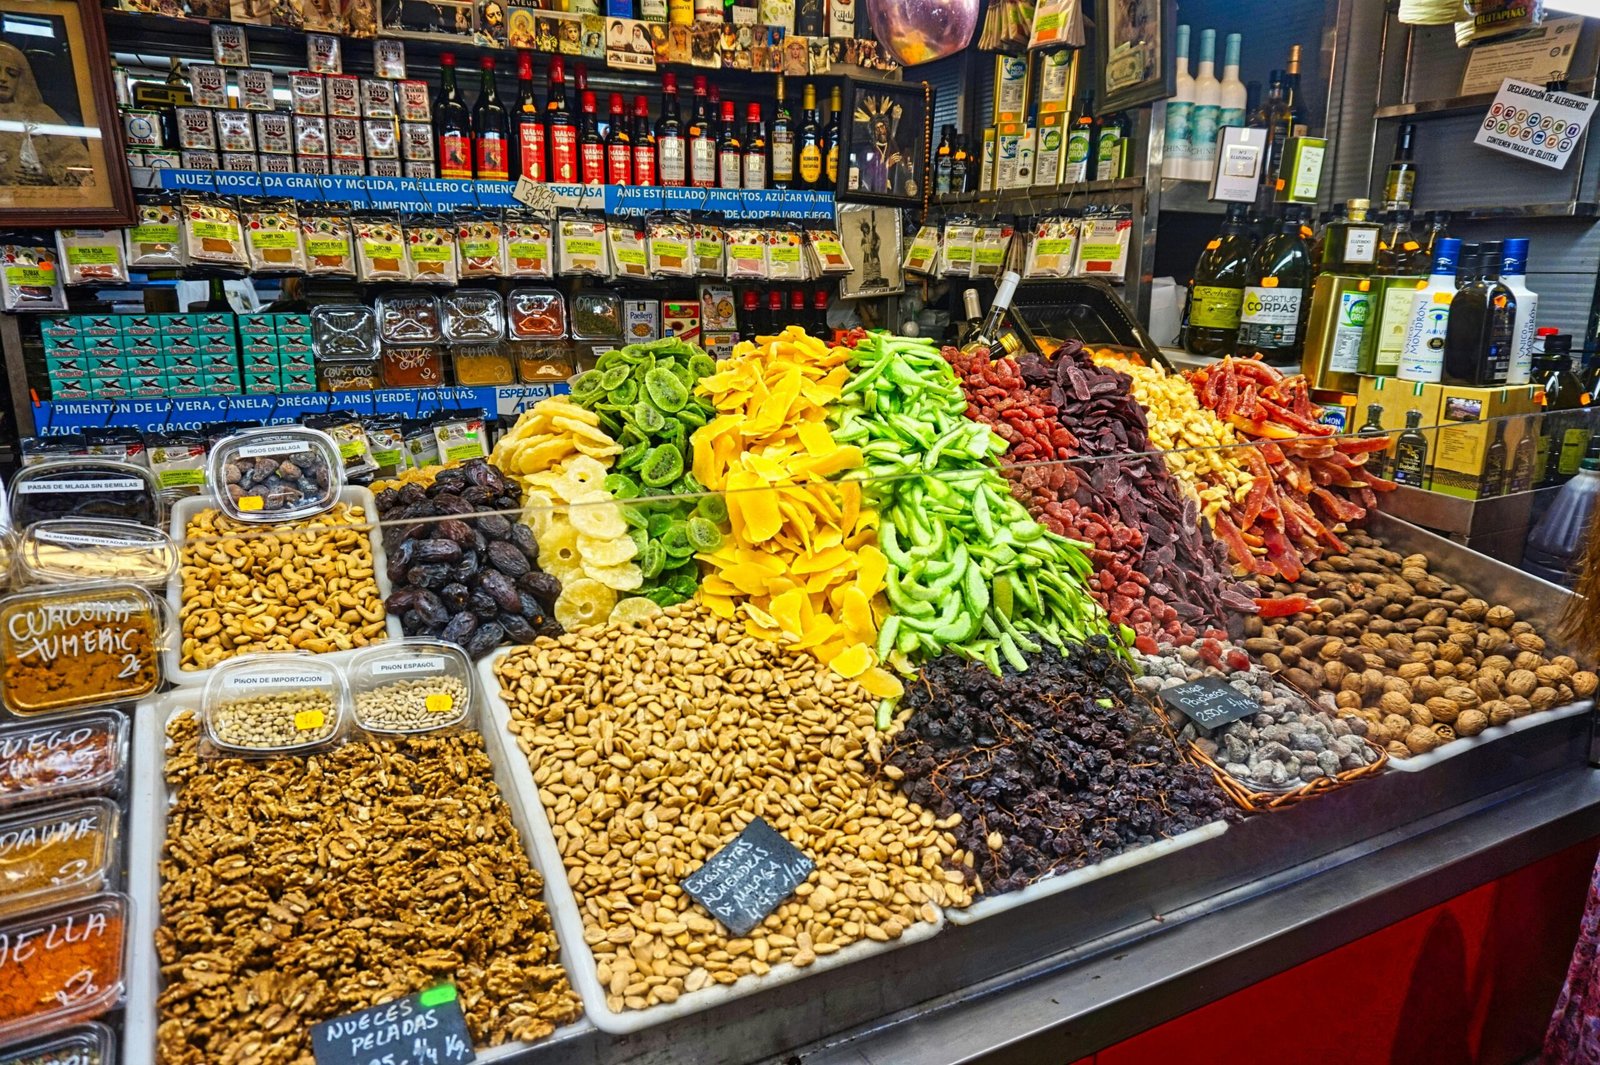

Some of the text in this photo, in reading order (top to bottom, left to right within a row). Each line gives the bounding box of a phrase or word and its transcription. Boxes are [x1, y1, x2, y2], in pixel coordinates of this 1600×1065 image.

[1475, 7, 1526, 26] QUITAPENAS
[334, 88, 353, 96] 1921
[1507, 83, 1546, 100] DECLARACIÓN
[1545, 93, 1554, 103] DE
[186, 119, 208, 127] 1921
[265, 124, 286, 132] 1921
[336, 128, 356, 136] 1921
[1486, 136, 1559, 163] CONTIENEN TRAZAS DE GLUTEN
[176, 174, 213, 185] NUEZ
[286, 177, 332, 189] GRANO
[334, 178, 342, 189] Y
[401, 181, 458, 192] PAELLERO
[551, 186, 594, 197] ESPECIAS
[616, 188, 641, 199] ANIS
[643, 190, 706, 201] ESTRELLADO
[766, 193, 802, 202] AZUCAR
[1260, 294, 1298, 303] CORTIJO
[1247, 302, 1297, 313] CORPAS
[630, 311, 653, 320] Paellero
[1410, 300, 1428, 355] MONDRÓN
[499, 387, 544, 398] ESPECIAS
[56, 404, 131, 415] PIMENTON
[135, 402, 153, 412] DE
[157, 402, 172, 412] LA
[176, 400, 216, 412] VERA,
[218, 396, 273, 410] CANELA,
[344, 394, 371, 404] ANIS
[374, 391, 414, 403] VERDE,
[418, 389, 477, 402] MORUNAS,
[1324, 417, 1341, 425] MON
[247, 447, 267, 455] HIGOS
[44, 533, 128, 546] ALMENDRAS TOSTADAS
[271, 676, 322, 684] IMPORTACION
[0, 728, 92, 759] UEGO
[327, 999, 414, 1042] NUECES
[352, 1008, 439, 1057] PELADAS
